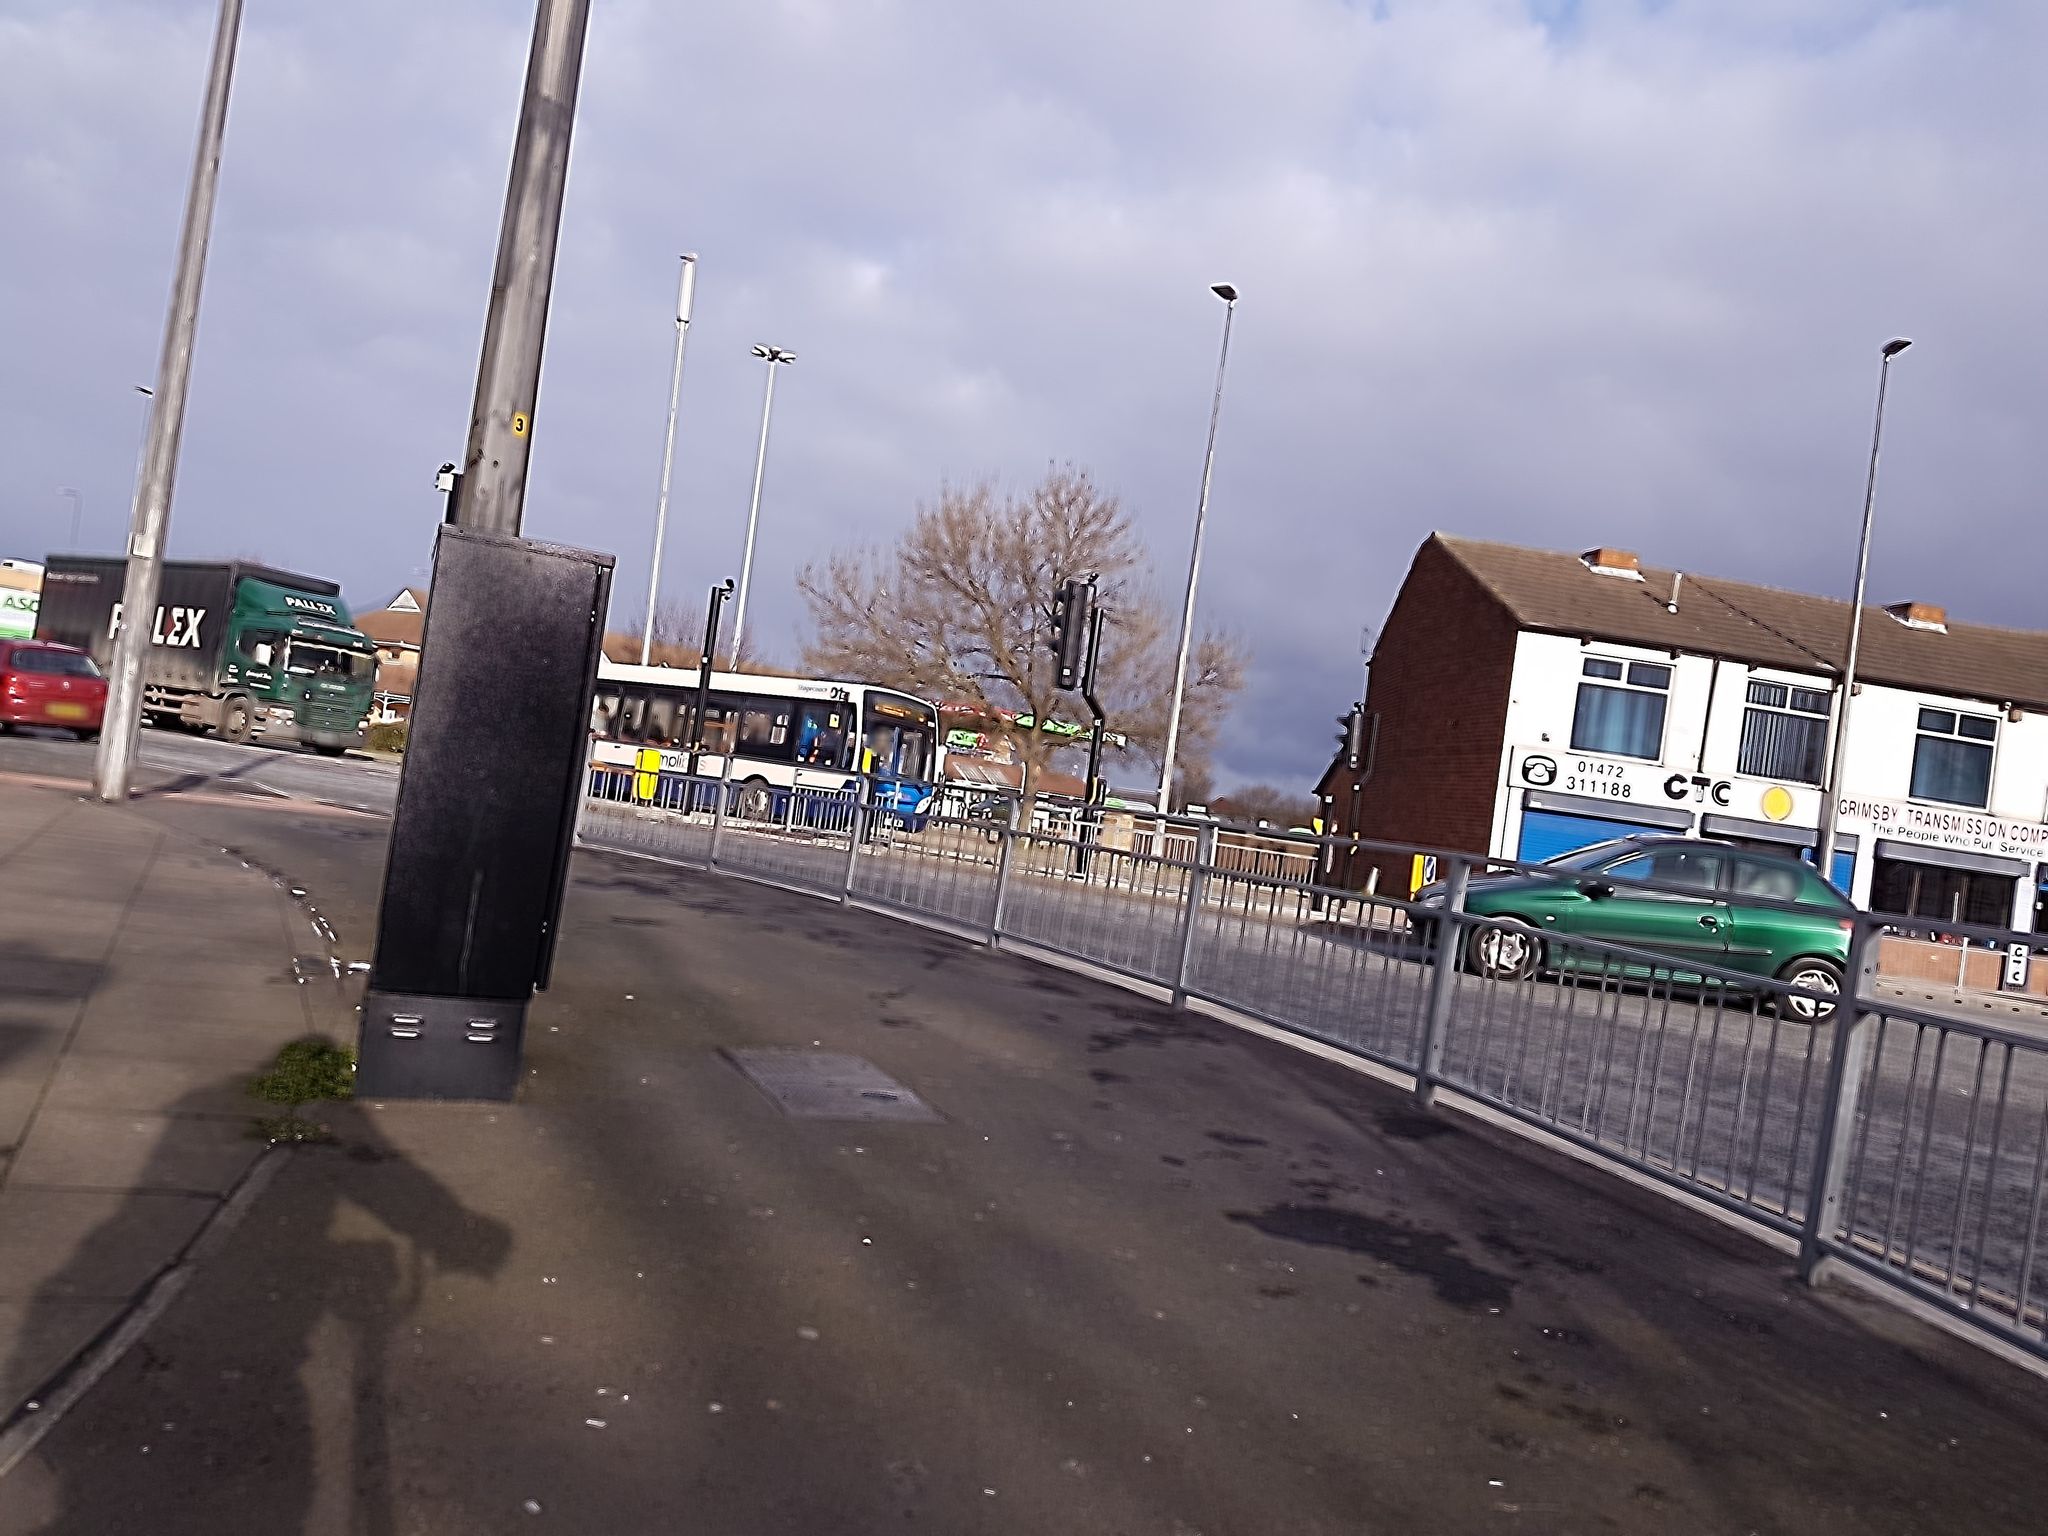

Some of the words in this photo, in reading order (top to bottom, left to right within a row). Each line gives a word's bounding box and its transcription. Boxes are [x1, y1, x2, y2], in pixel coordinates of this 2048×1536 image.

[515, 417, 524, 432] 3
[108, 603, 206, 648] PLEX
[1578, 760, 1625, 779] 01472
[1566, 776, 1632, 798] 311188
[1663, 773, 1732, 807] CTC
[1839, 799, 1898, 821] GRIMSBY
[1907, 809, 2006, 839] TRANSMISSION
[2011, 825, 2048, 844] COMP
[1871, 822, 1894, 836] The
[1897, 826, 1940, 843] People
[1943, 833, 1971, 847] Who
[1973, 837, 1993, 850] Put
[2000, 841, 2044, 857] Service
